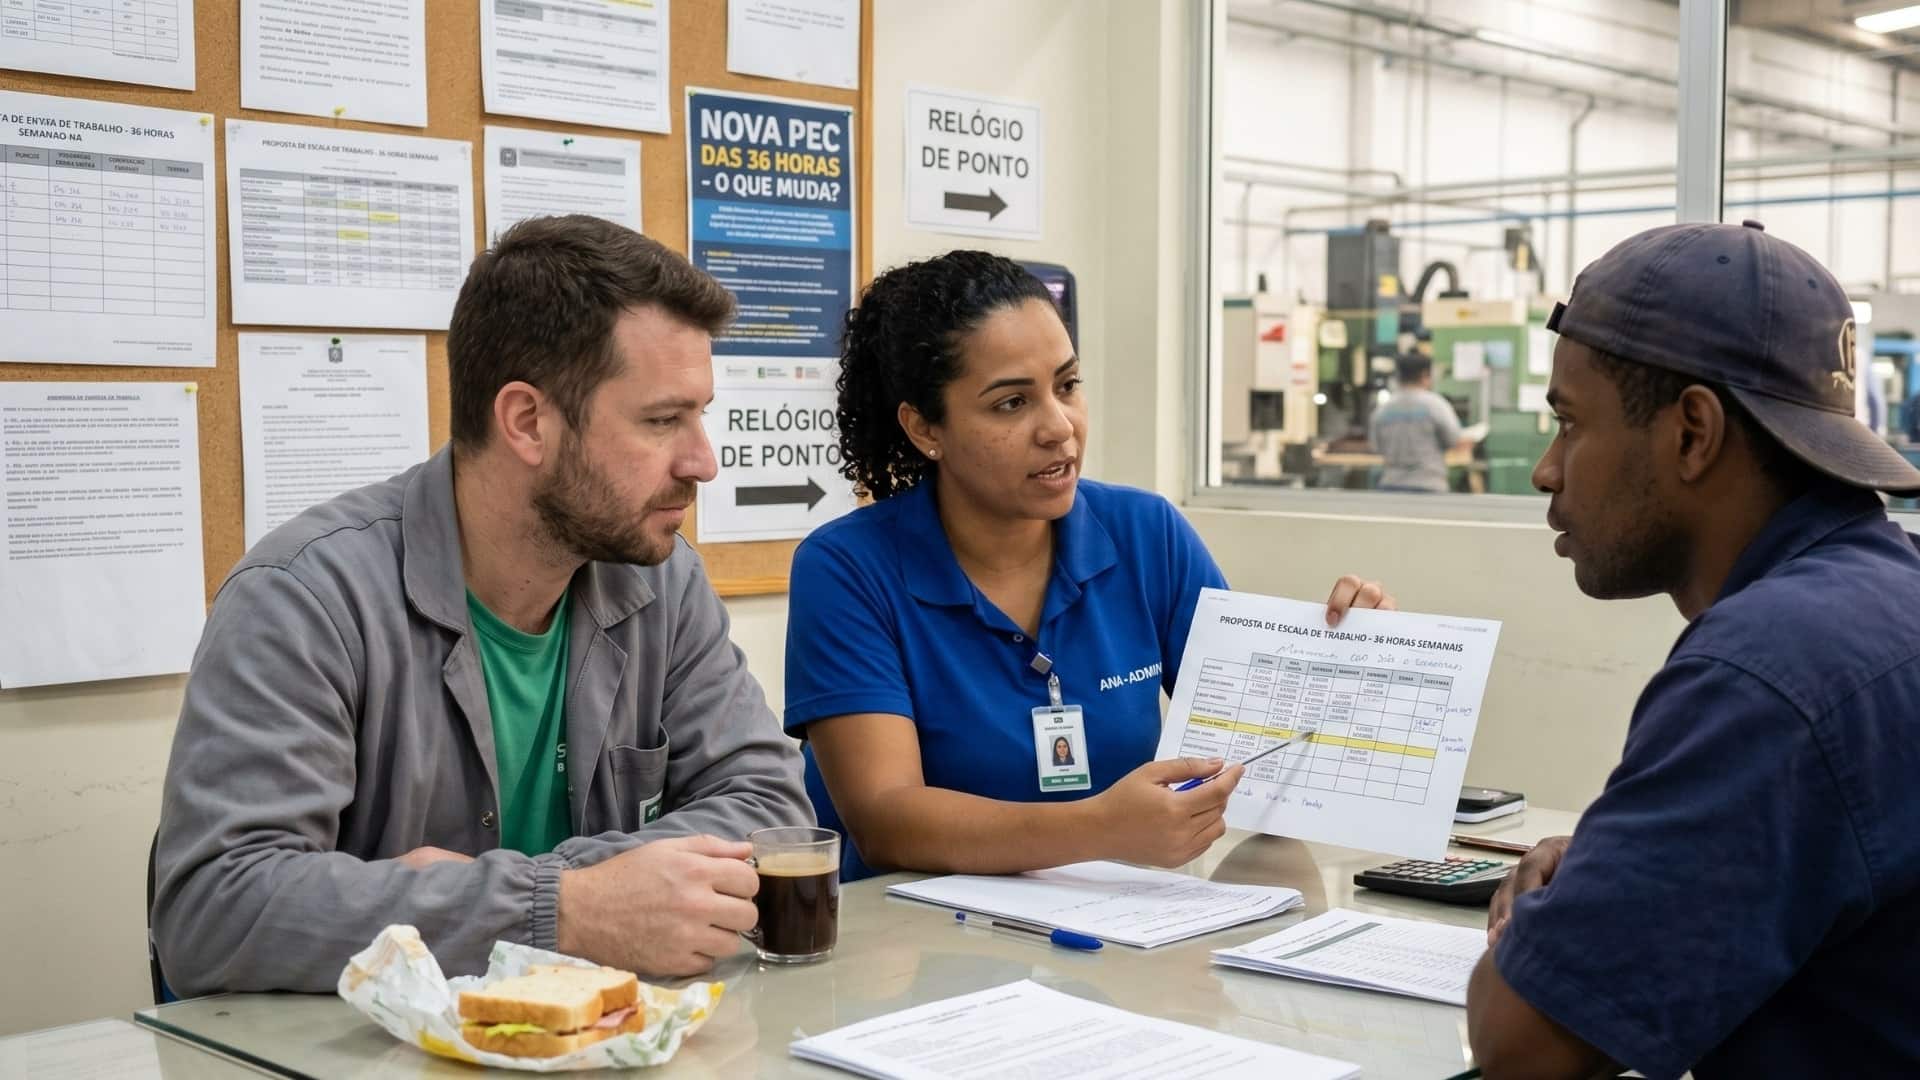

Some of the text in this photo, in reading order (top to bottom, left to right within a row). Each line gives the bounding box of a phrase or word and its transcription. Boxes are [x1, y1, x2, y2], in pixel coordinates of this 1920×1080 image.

[11, 114, 24, 124] DE
[59, 119, 71, 128] DE
[74, 120, 123, 134] TRABALHO
[130, 127, 142, 136] 36
[143, 128, 175, 139] HORAS
[701, 108, 841, 152] NOVA PEC
[928, 108, 1023, 142] RELÓGIO
[701, 144, 841, 177] DAS 36 HORAS
[922, 146, 1029, 178] DE PONTO
[714, 172, 730, 193] O
[733, 174, 773, 198] QUE
[776, 178, 841, 202] MUDA?
[728, 403, 834, 431] RELÓGIO
[721, 444, 842, 468] DE PONTO
[1219, 615, 1263, 629] PROPOSTA
[1264, 622, 1276, 631] DE
[1277, 624, 1309, 636] ESCALA
[1310, 629, 1322, 638] DE
[1324, 630, 1367, 642] TRABALHO
[1373, 635, 1385, 644] 36
[1386, 636, 1416, 647] HORAS
[1417, 639, 1464, 652] SEMANAIS
